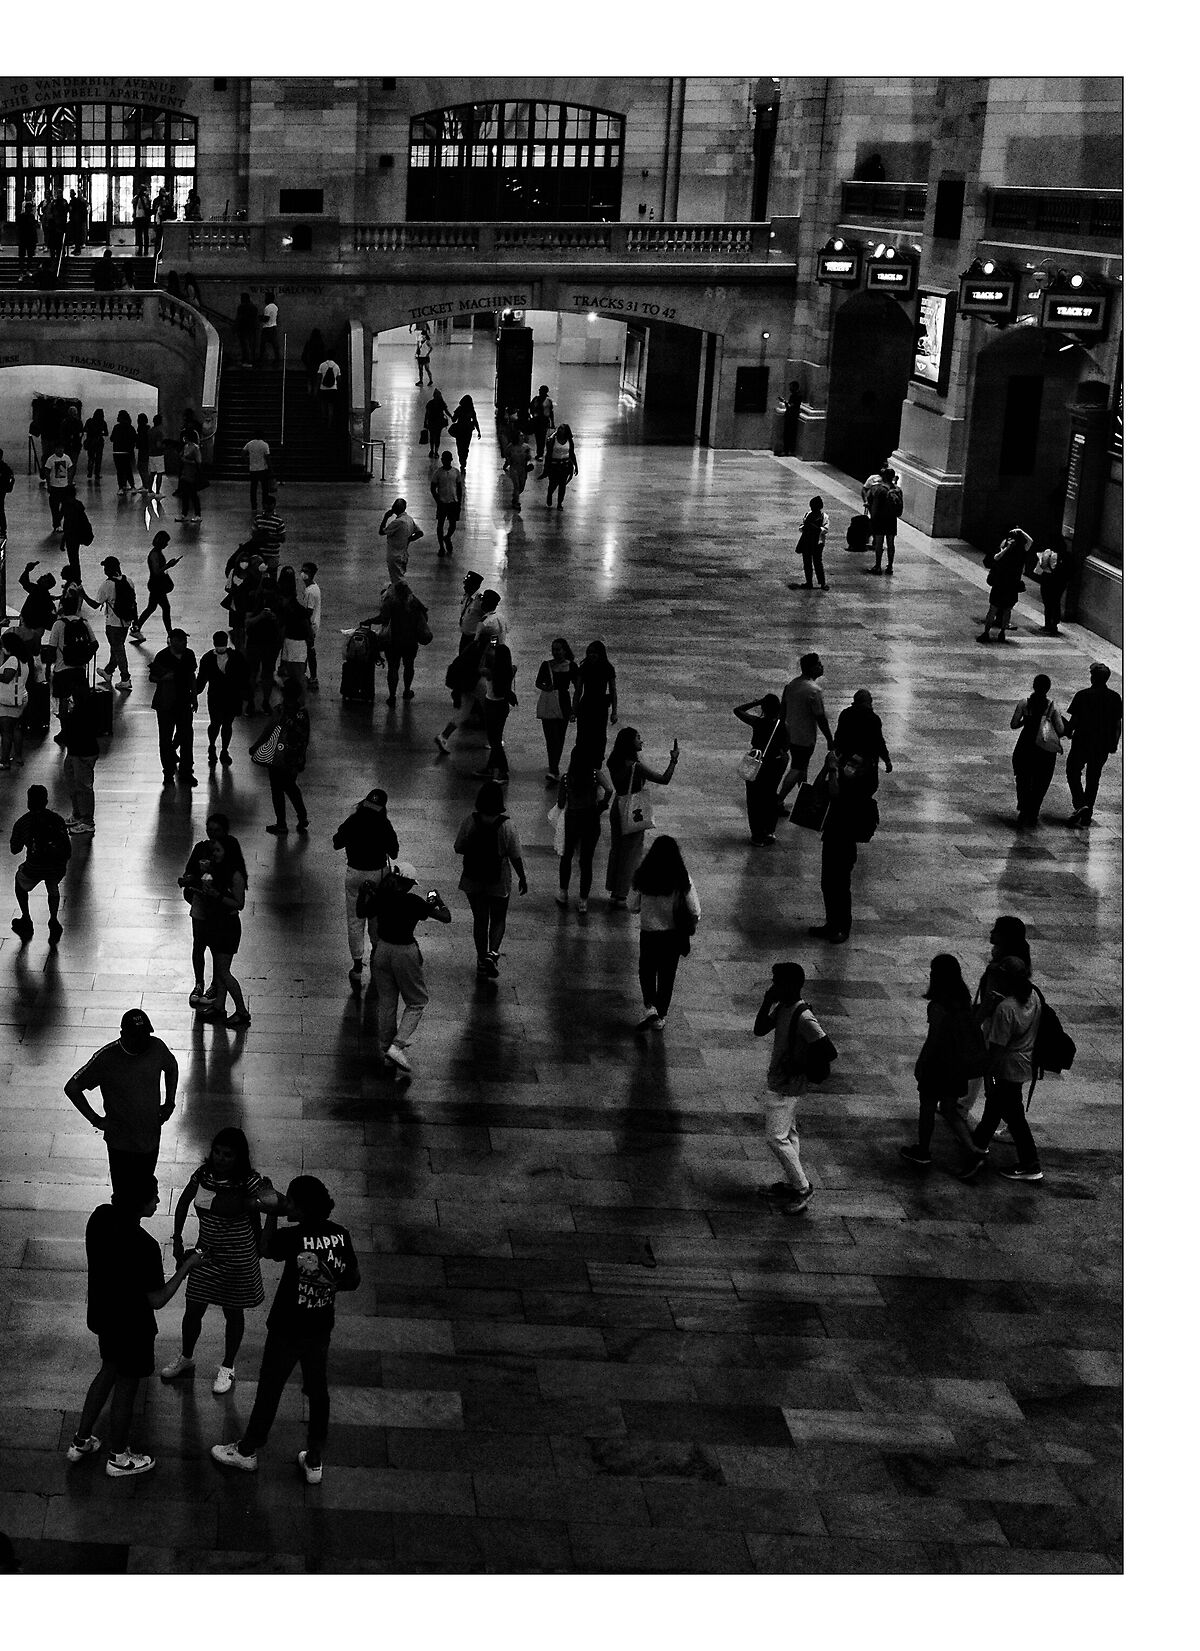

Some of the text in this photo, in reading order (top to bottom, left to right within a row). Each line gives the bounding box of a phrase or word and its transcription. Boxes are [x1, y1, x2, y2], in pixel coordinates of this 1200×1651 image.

[10, 78, 176, 95] TO VANDERBILT AVENUE
[1, 87, 186, 108] THE CAMPBELL APARTMENT
[972, 291, 994, 300] TRACK
[408, 295, 527, 319] TICKET MACHINES
[573, 295, 676, 319] TRACKS 31 TO 42
[1056, 307, 1083, 316] TRACK
[69, 355, 101, 366] TRACKS
[303, 1234, 345, 1250] HAPPY
[327, 1249, 346, 1272] AND
